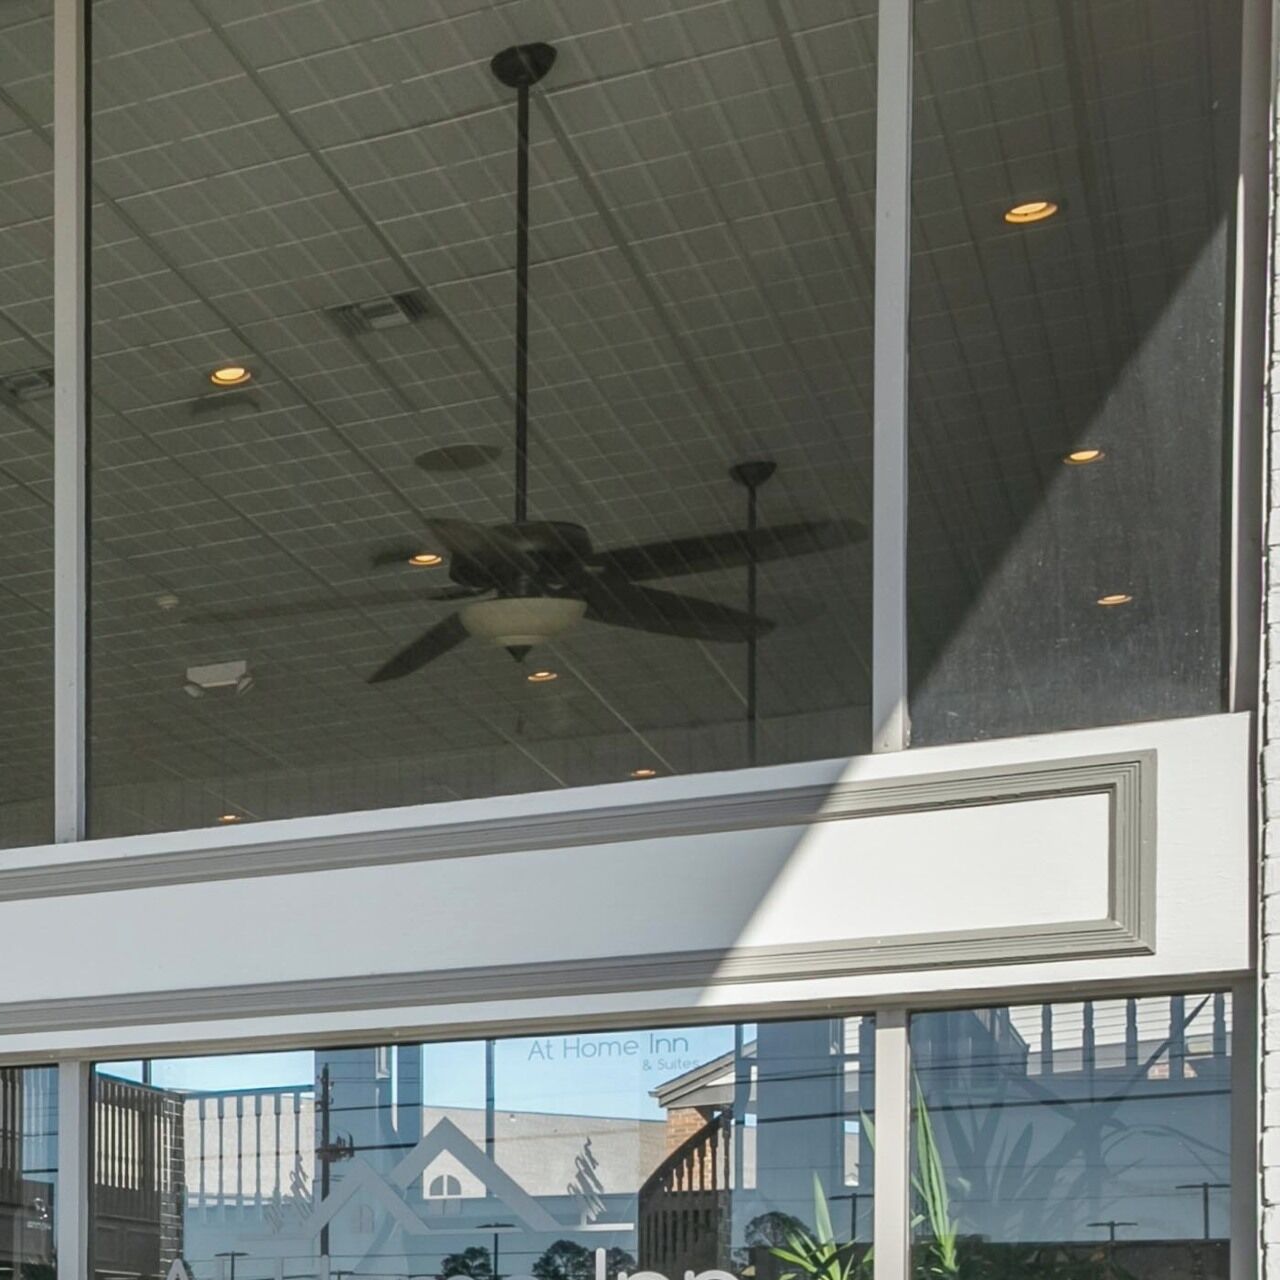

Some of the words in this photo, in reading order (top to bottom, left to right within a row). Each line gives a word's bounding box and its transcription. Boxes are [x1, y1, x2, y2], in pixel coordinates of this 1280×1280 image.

[528, 1039, 556, 1061] At
[563, 1036, 639, 1059] Home
[649, 1032, 689, 1055] Inn
[657, 1057, 700, 1071] Suites
